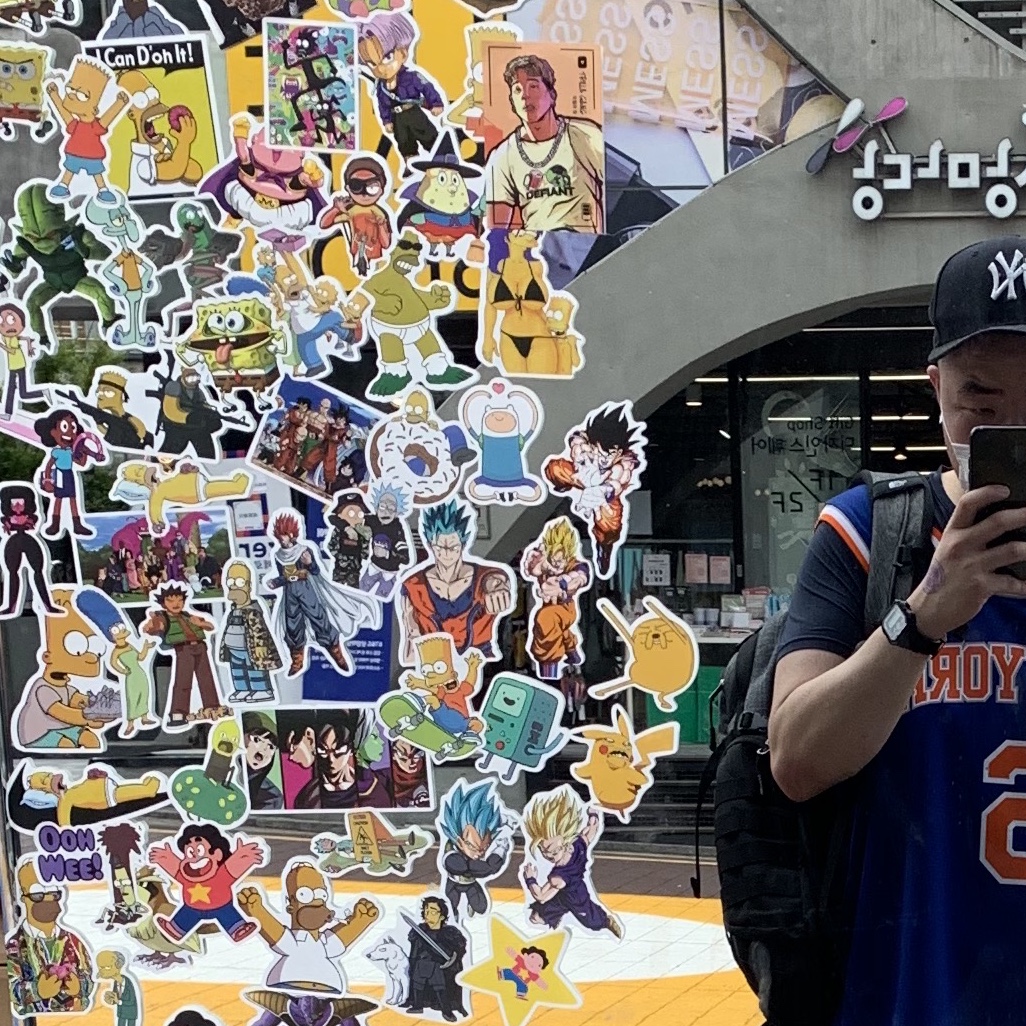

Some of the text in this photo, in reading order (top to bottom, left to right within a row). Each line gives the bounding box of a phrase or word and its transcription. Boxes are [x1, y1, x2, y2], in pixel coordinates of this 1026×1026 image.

[104, 47, 135, 68] Can
[136, 45, 173, 66] D'oh
[174, 43, 194, 63] It!
[526, 185, 576, 201] DEFIANT
